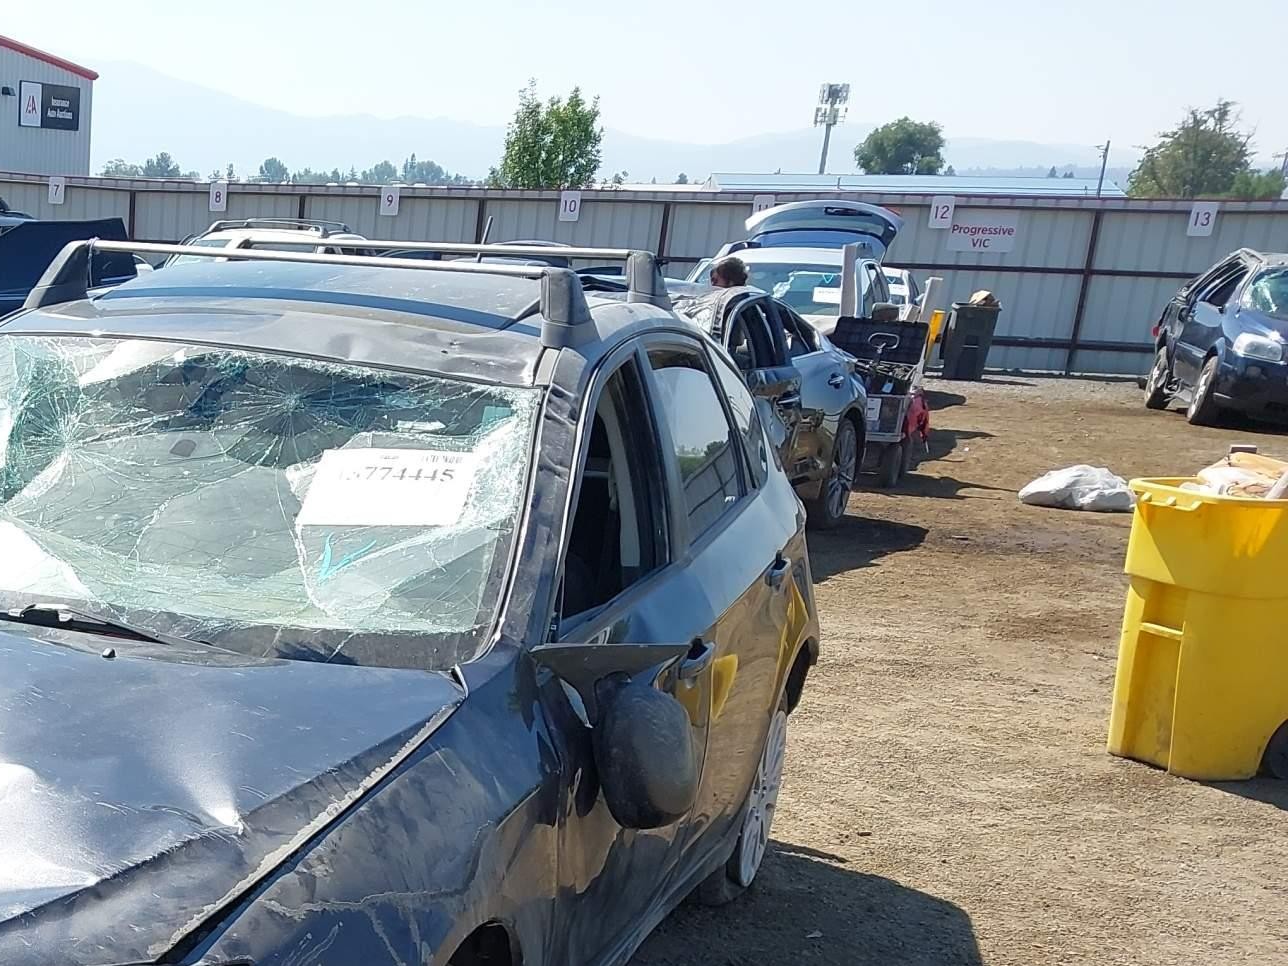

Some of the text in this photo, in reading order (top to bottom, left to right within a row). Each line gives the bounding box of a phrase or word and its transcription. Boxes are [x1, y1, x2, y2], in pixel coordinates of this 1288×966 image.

[53, 183, 60, 197] 7
[214, 190, 222, 204] 8
[386, 194, 394, 207] 9
[563, 199, 577, 213] 10
[934, 204, 951, 220] 12
[1193, 211, 1211, 227] 13
[952, 224, 1015, 236] Progressive
[971, 238, 991, 249] VIC
